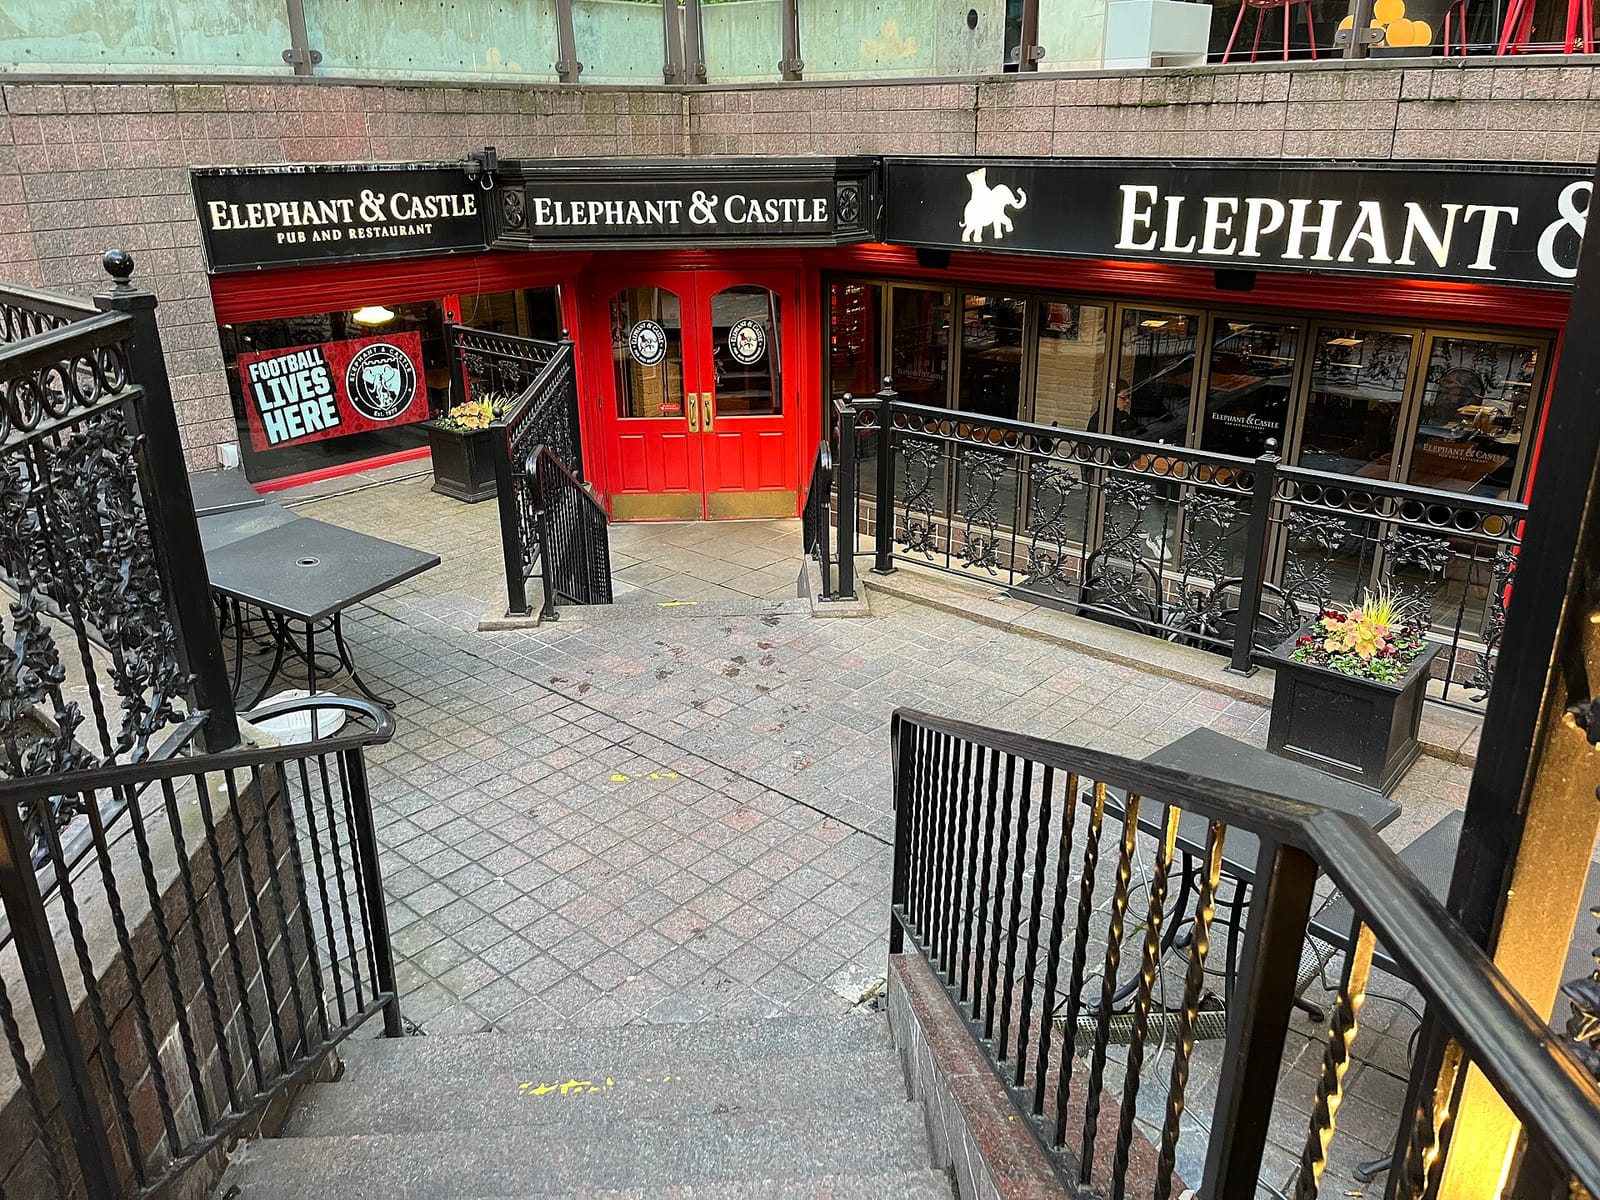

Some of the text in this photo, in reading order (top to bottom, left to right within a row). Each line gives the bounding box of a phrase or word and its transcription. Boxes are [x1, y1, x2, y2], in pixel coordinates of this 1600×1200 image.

[207, 189, 477, 231] ELEPHANT & CASTLE
[533, 190, 828, 225] ELEPHANT & CASTLE
[277, 223, 433, 244] PUB AND RESTAURANT
[1114, 181, 1594, 278] ELEPHANT &
[249, 348, 324, 382] FOOTBALL
[349, 347, 377, 382] ELEPHANT
[389, 349, 412, 373] CASTLE
[254, 366, 331, 412] LIVES
[263, 394, 340, 445] HERE
[1212, 412, 1246, 424] ELEPHANT
[1254, 418, 1280, 429] CASTLE
[1422, 443, 1465, 456] ELEPHANT
